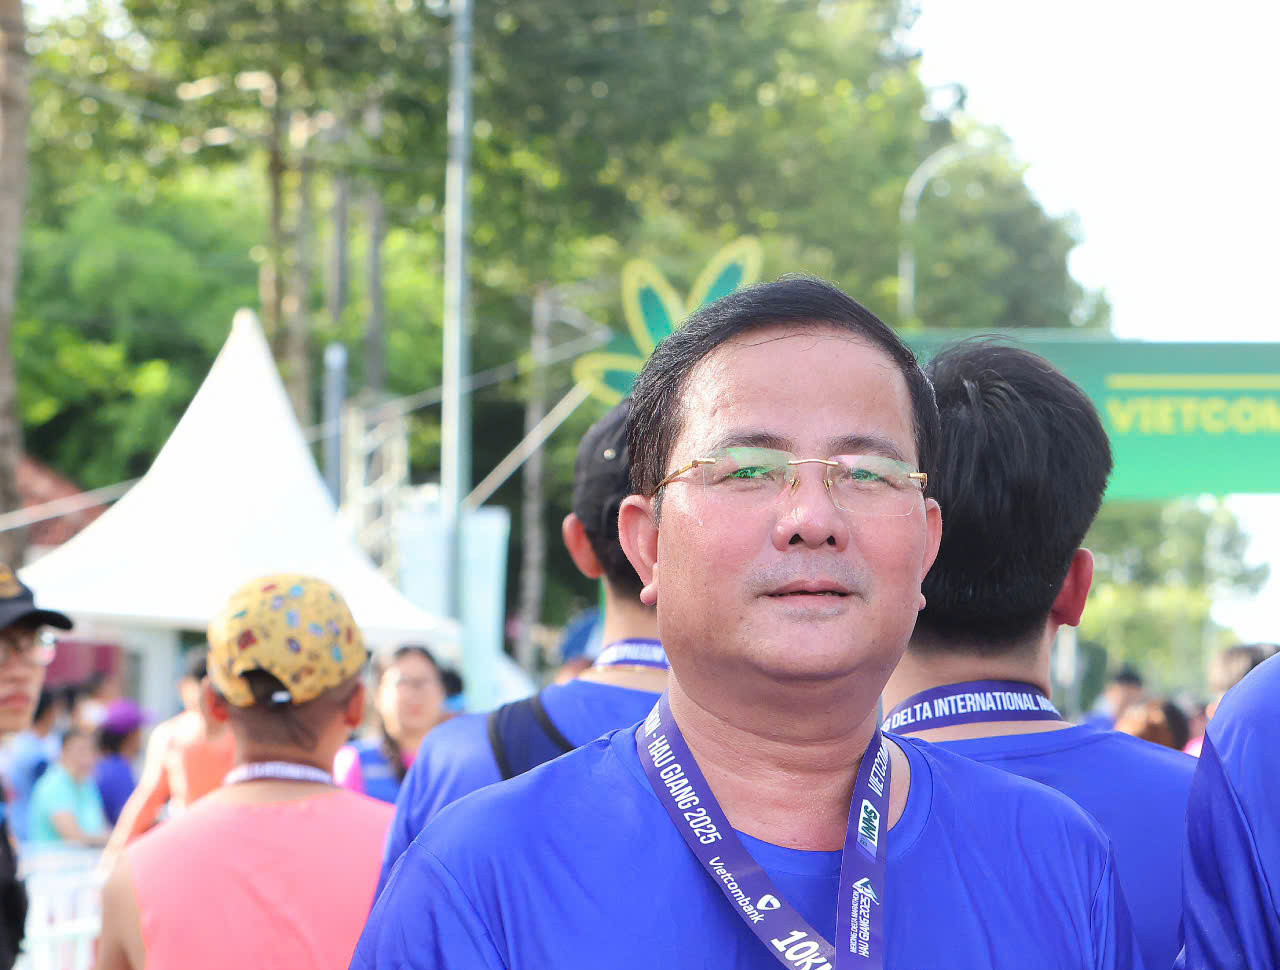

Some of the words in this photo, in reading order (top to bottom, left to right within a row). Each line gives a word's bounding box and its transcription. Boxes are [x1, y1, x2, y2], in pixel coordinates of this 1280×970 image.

[892, 701, 932, 730] DELTA
[934, 691, 1039, 718] INTERNATIONAL
[647, 735, 675, 768] HAU
[660, 763, 699, 810] GIANG
[683, 807, 722, 845] 2025
[861, 805, 878, 842] VNMS
[709, 856, 764, 924] Vietcombank
[860, 894, 870, 918] 2025
[859, 916, 870, 941] GIANG
